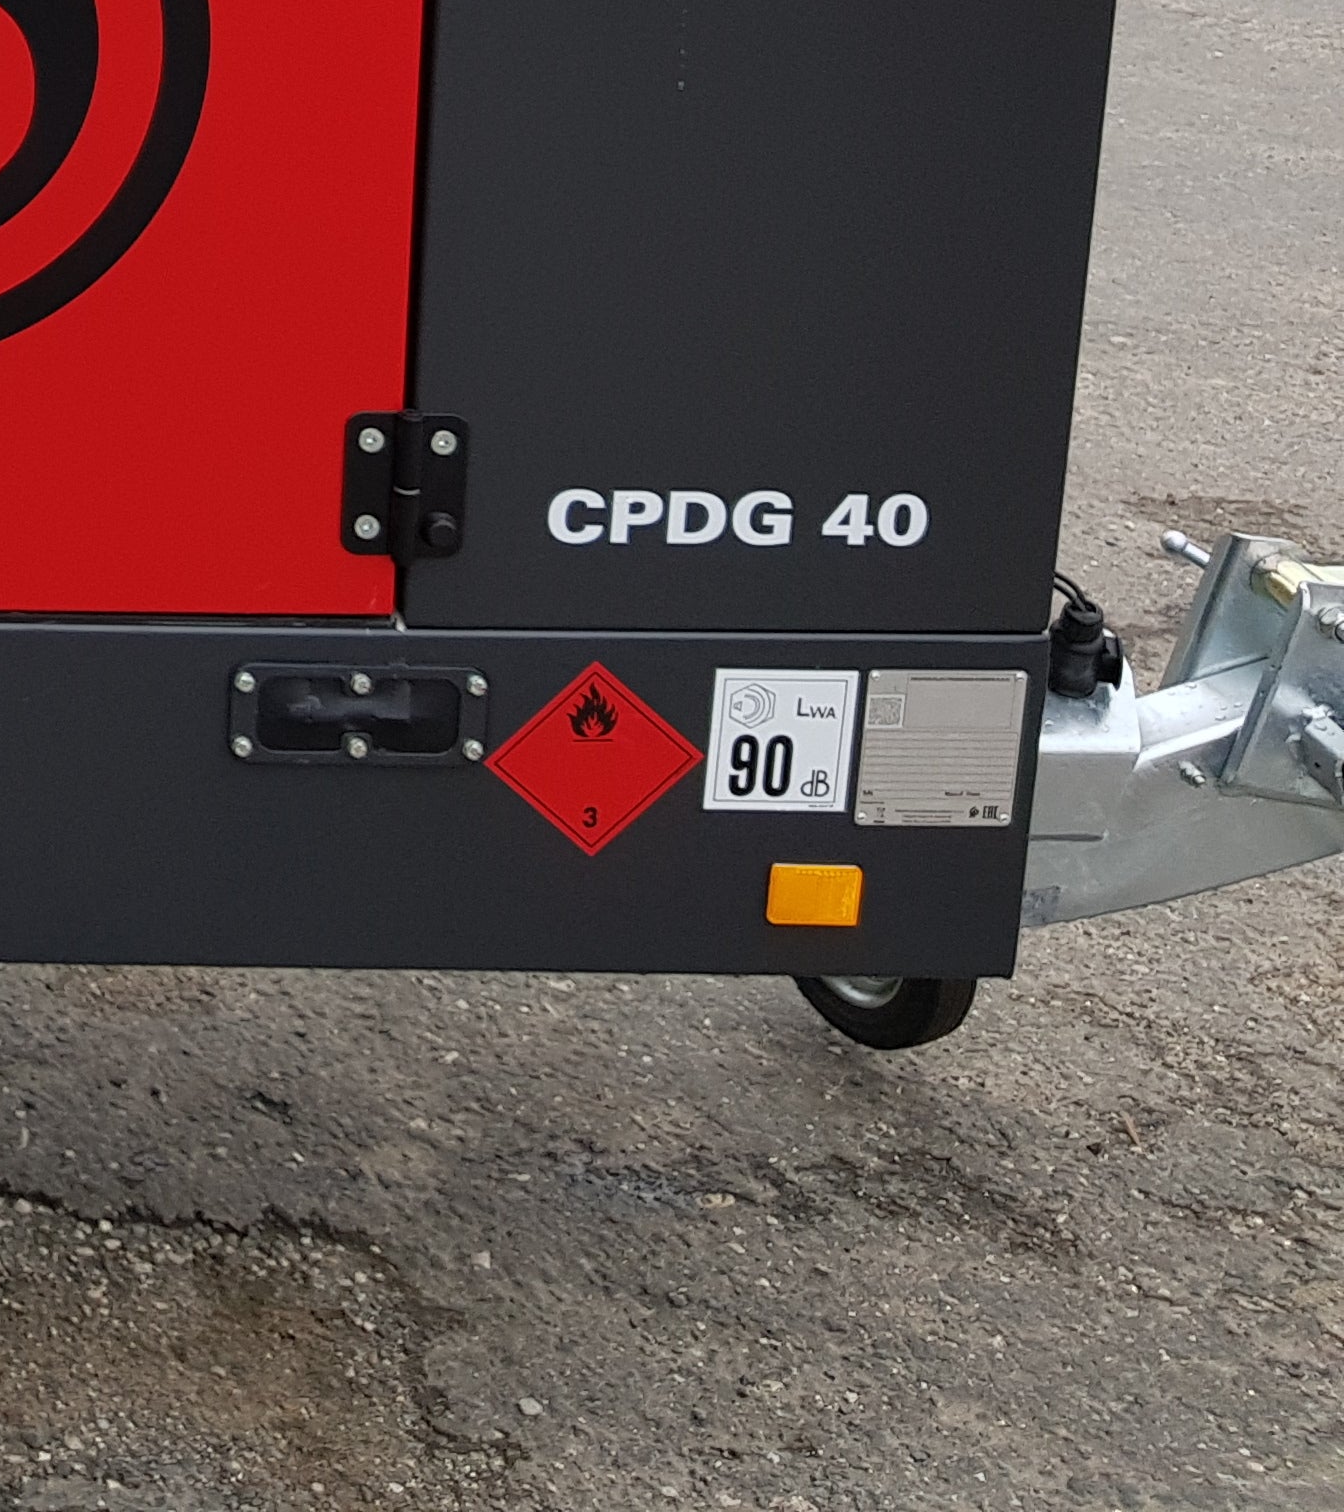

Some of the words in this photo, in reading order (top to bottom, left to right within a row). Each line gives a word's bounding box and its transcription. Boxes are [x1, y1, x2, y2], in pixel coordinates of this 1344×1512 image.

[548, 488, 793, 546] CPDG
[821, 493, 929, 547] 40
[728, 734, 794, 798] 90
[800, 769, 830, 797] dB
[582, 807, 597, 828] 3
